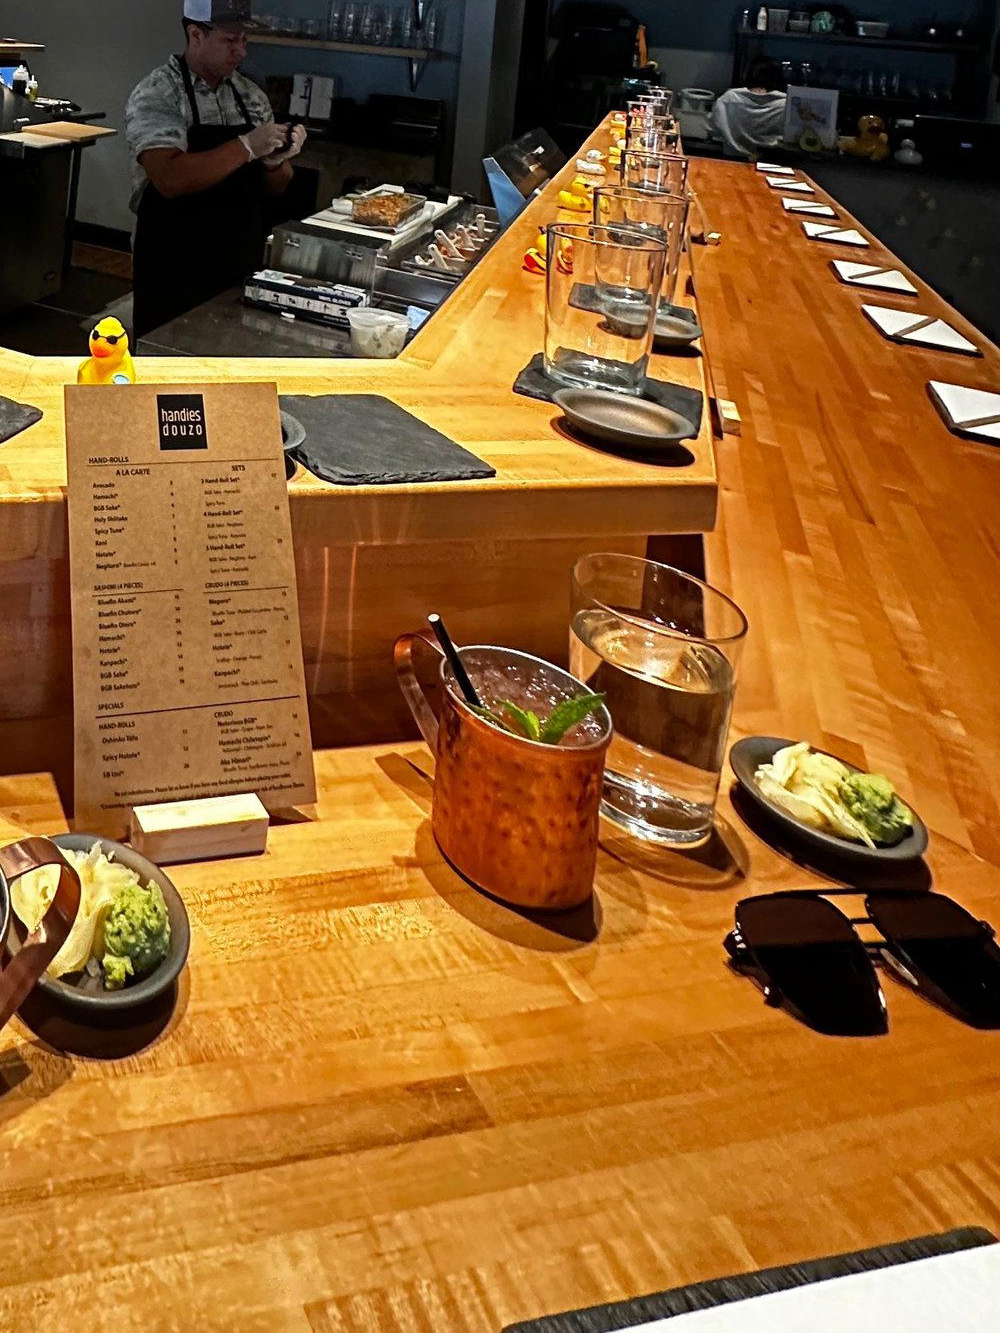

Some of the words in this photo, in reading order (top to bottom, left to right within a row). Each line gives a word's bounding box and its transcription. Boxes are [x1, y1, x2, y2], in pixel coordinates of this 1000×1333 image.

[161, 408, 201, 422] handies
[162, 423, 203, 436] douzo
[88, 456, 129, 464] HAND-ROLLS
[97, 702, 124, 710] SPECIALS
[99, 721, 135, 731] HAND-ROLLS
